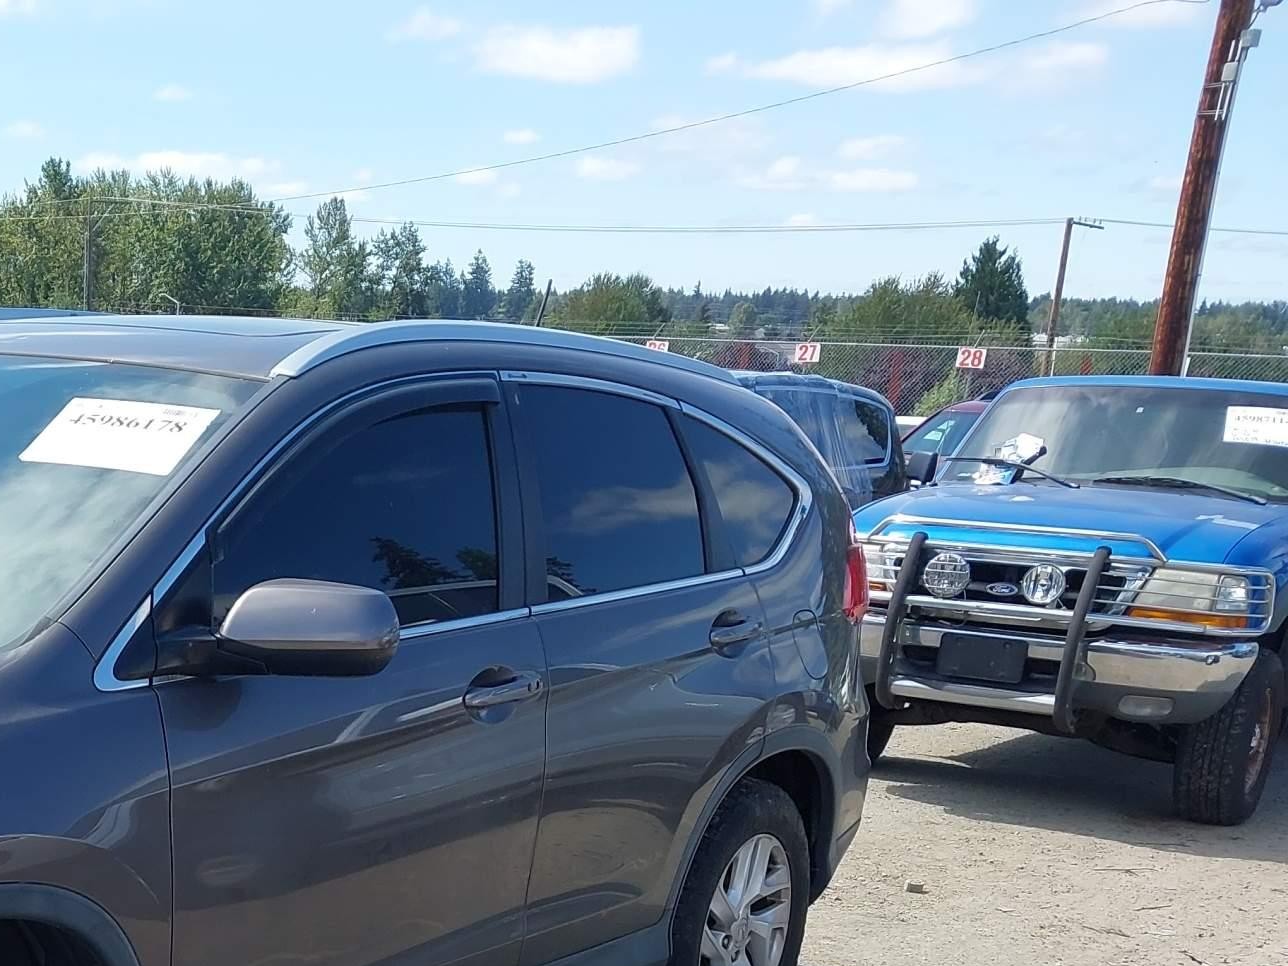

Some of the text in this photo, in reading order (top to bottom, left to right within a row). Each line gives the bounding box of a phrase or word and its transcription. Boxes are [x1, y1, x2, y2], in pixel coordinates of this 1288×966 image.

[798, 345, 818, 361] 27
[959, 350, 983, 367] 28
[69, 413, 187, 433] 45986178
